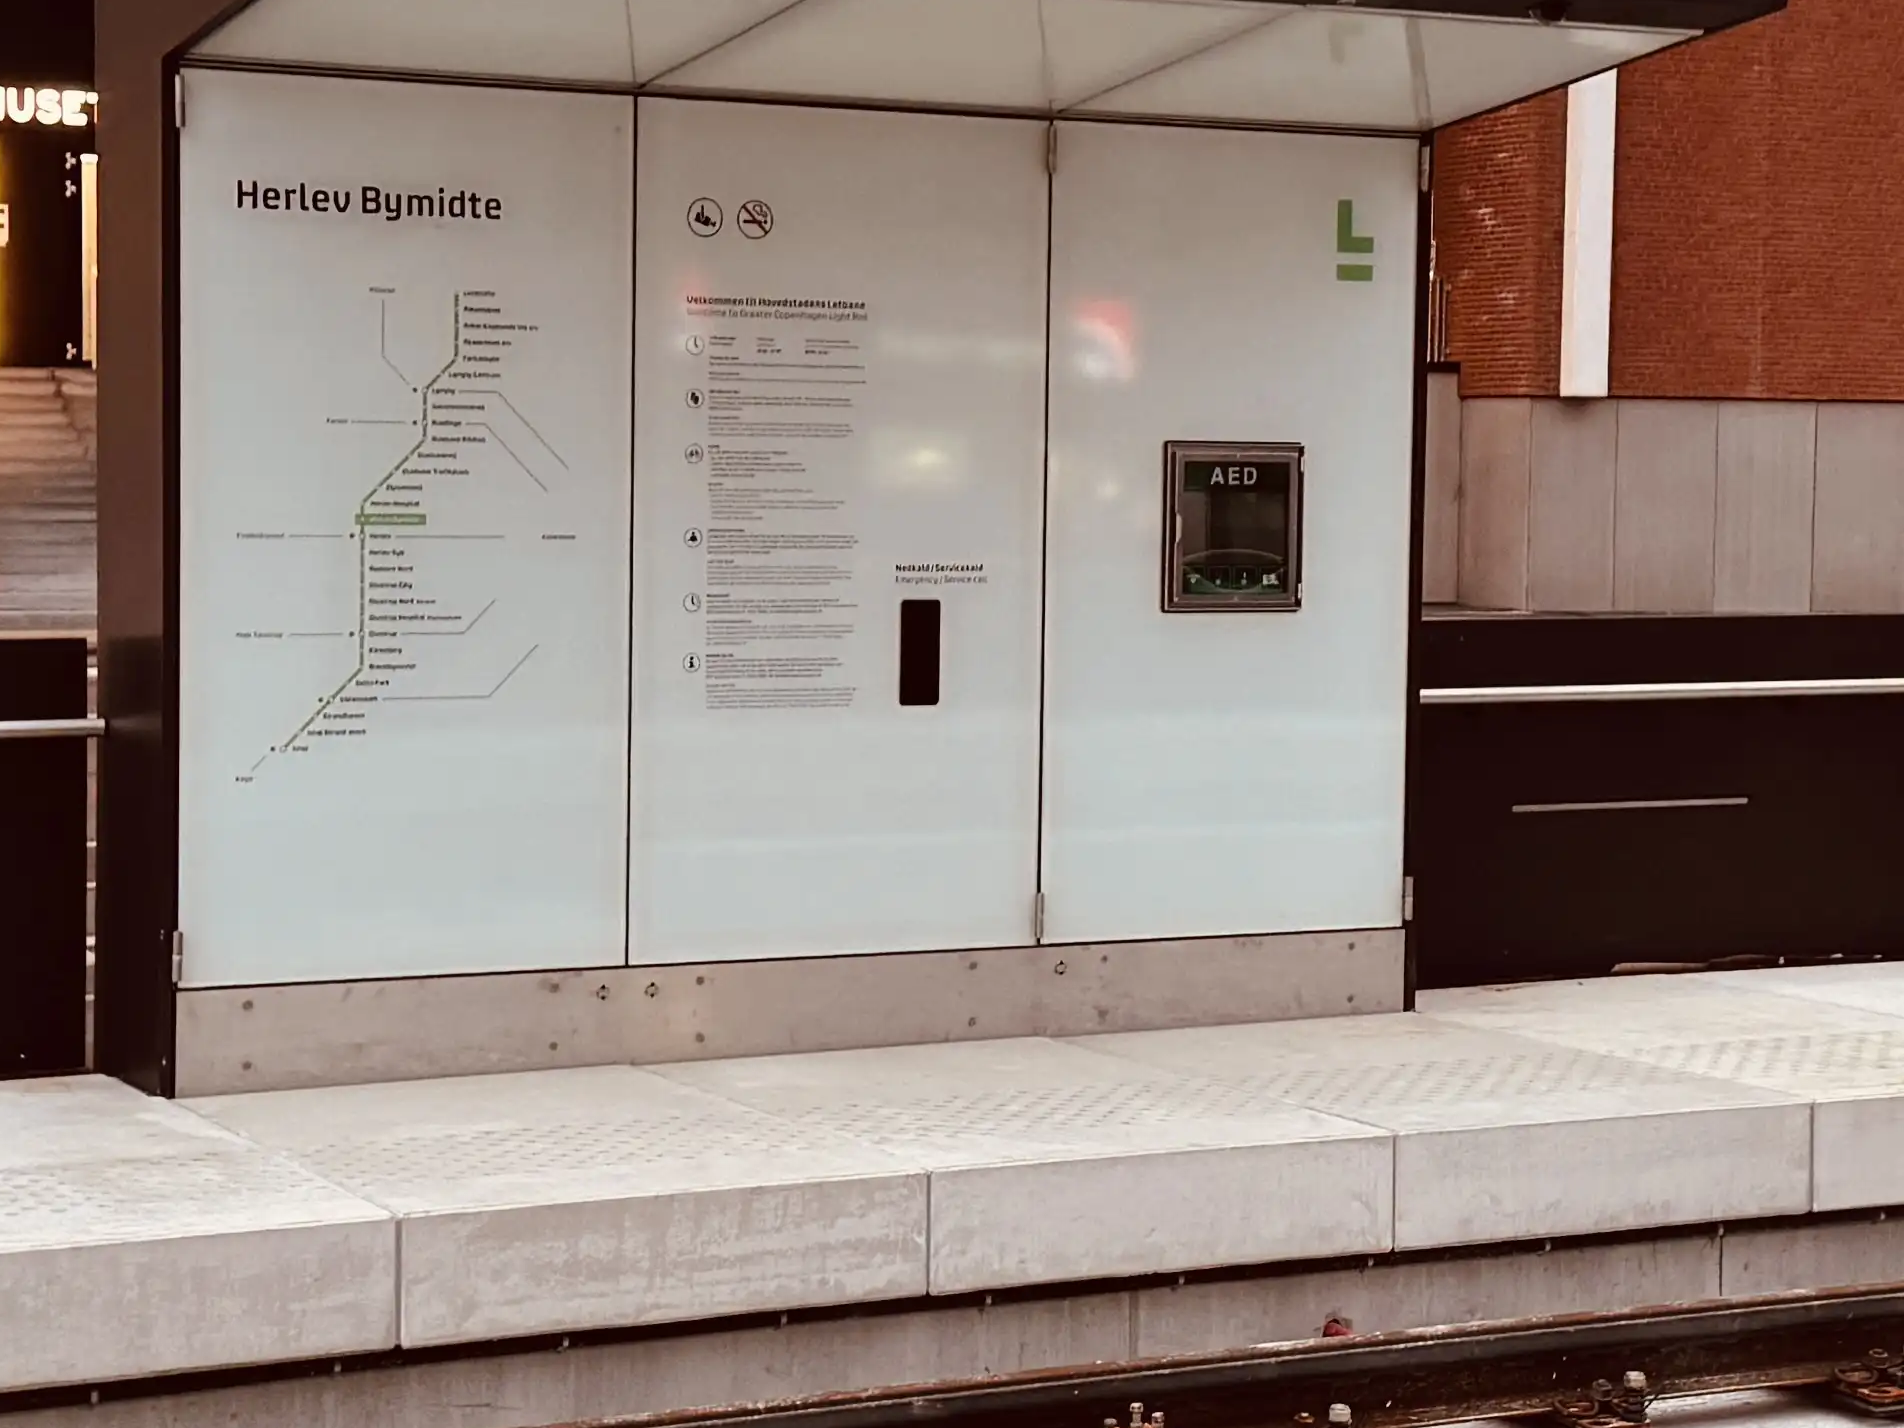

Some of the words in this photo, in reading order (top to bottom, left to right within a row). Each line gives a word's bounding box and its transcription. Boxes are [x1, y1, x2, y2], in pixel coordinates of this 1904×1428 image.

[236, 179, 351, 213] Herlev
[361, 186, 502, 222] Bymidte
[686, 294, 744, 306] Velkommen
[758, 297, 826, 309] Hovedstadens
[1210, 466, 1258, 485] AED
